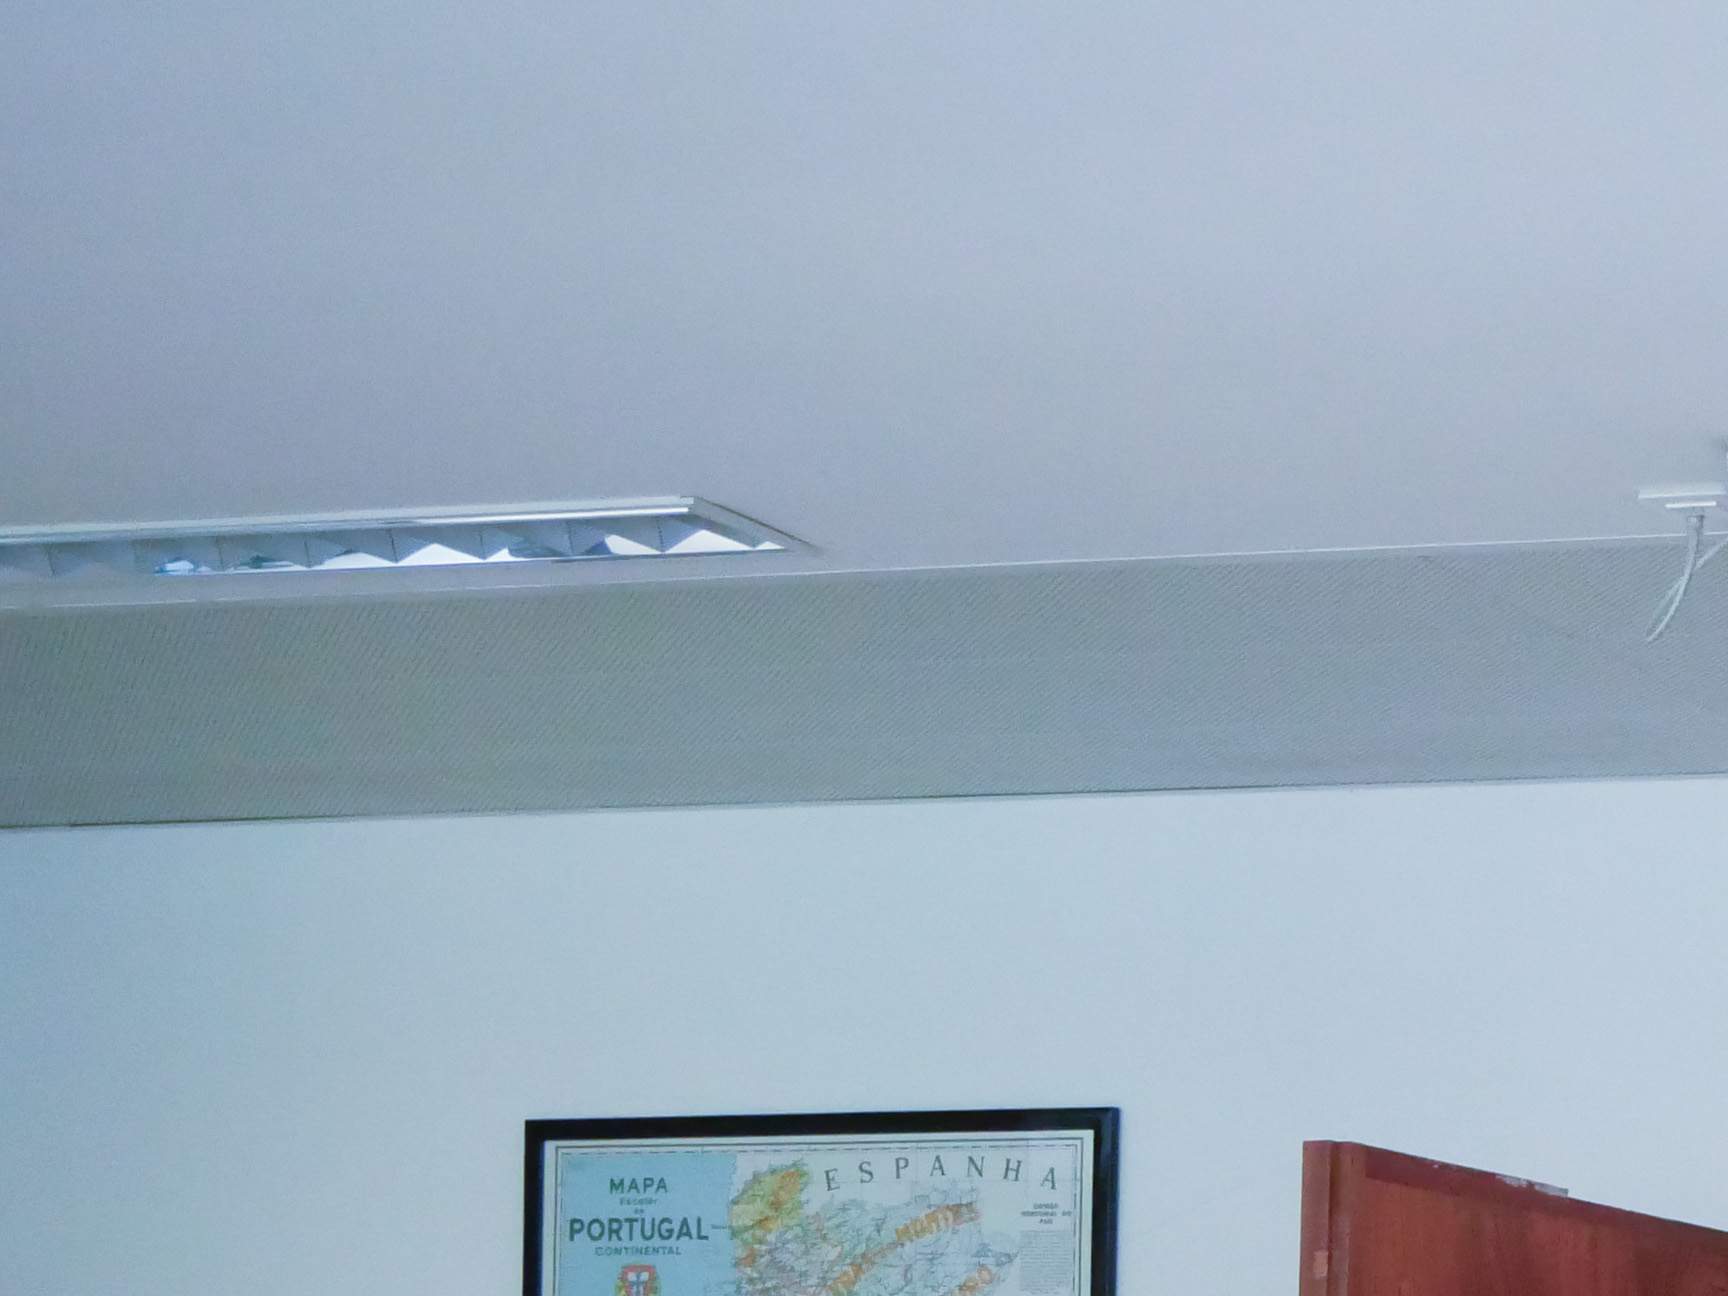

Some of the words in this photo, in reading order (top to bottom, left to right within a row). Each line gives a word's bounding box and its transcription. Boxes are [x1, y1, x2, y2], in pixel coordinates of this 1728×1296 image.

[825, 1154, 1058, 1191] ESPANHA
[609, 1177, 668, 1194] MAPA
[568, 1216, 710, 1242] PORTUGAL
[594, 1246, 682, 1256] CONTINENTAL
